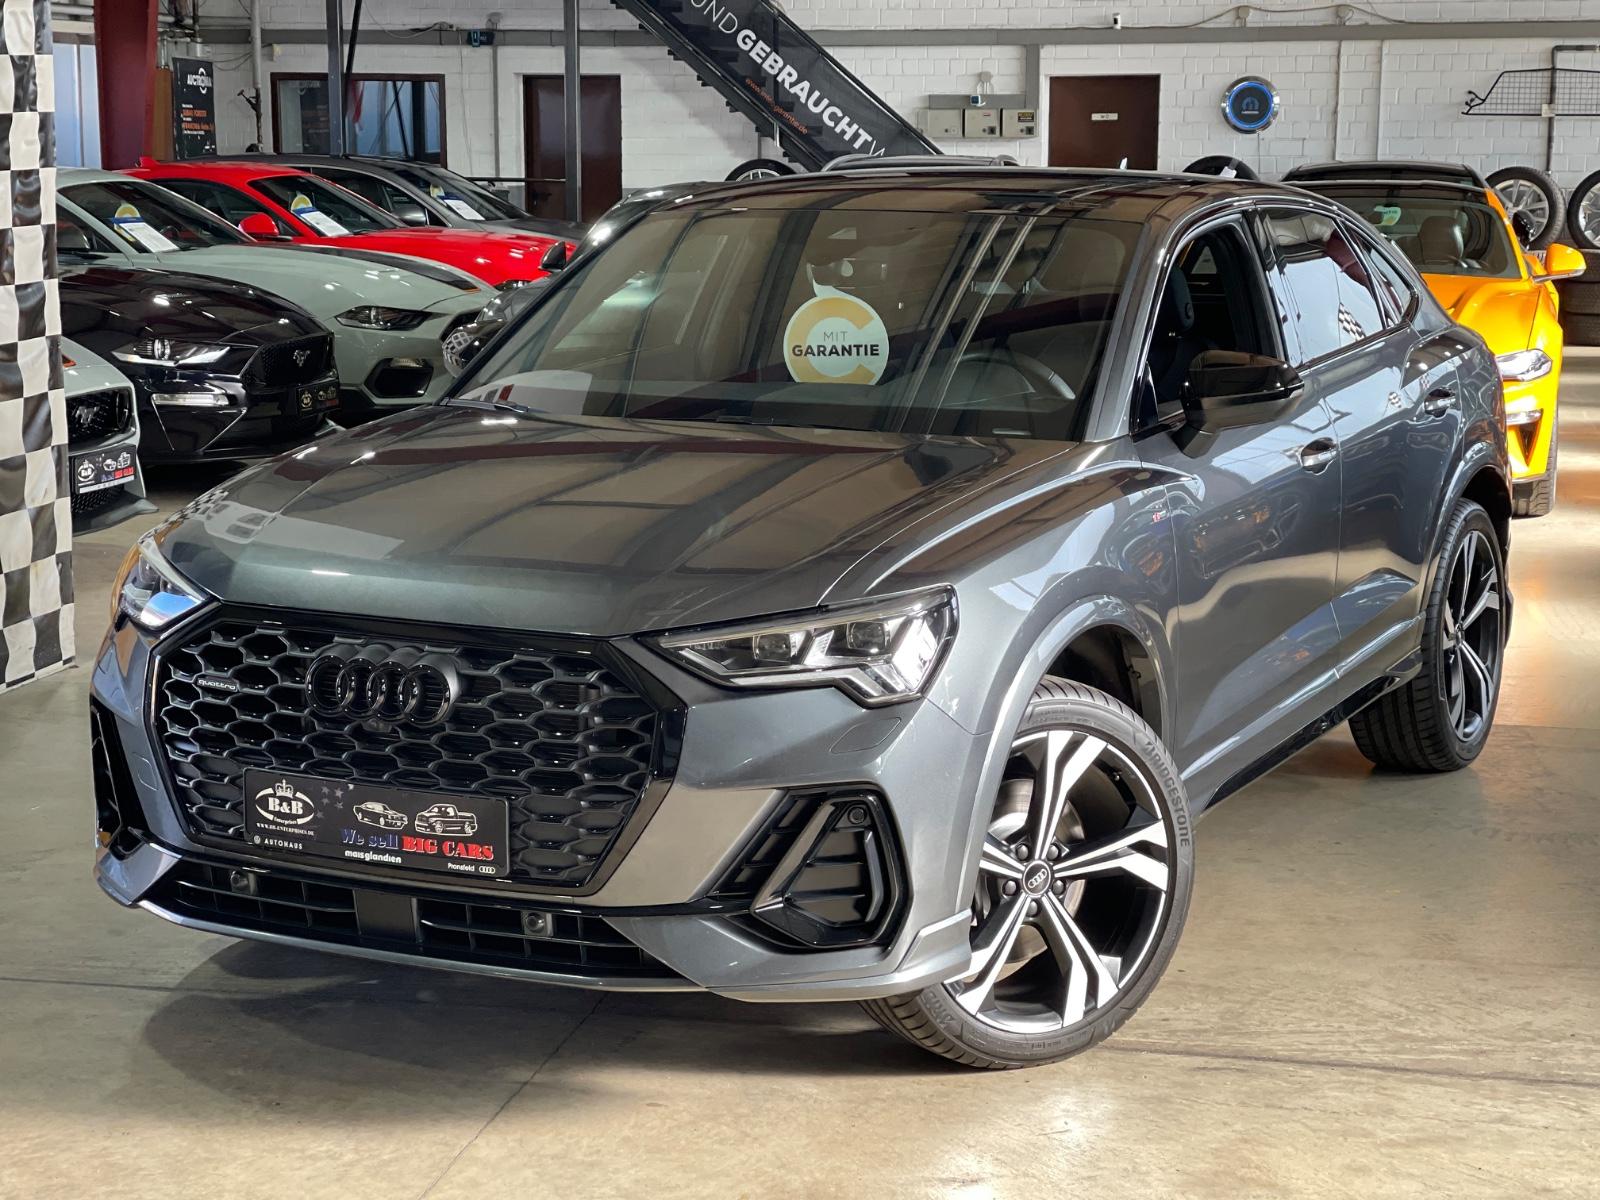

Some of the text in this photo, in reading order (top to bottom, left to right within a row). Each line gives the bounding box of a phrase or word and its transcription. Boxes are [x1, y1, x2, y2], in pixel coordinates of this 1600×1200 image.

[823, 331, 848, 342] MIT
[792, 344, 880, 357] GARANTIE
[198, 679, 236, 690] quattro
[1143, 740, 1190, 847] BRIDGESTONE
[268, 796, 303, 815] B&B
[264, 838, 303, 850] AUTOHAUS
[340, 828, 495, 861] We sell BIG CARS
